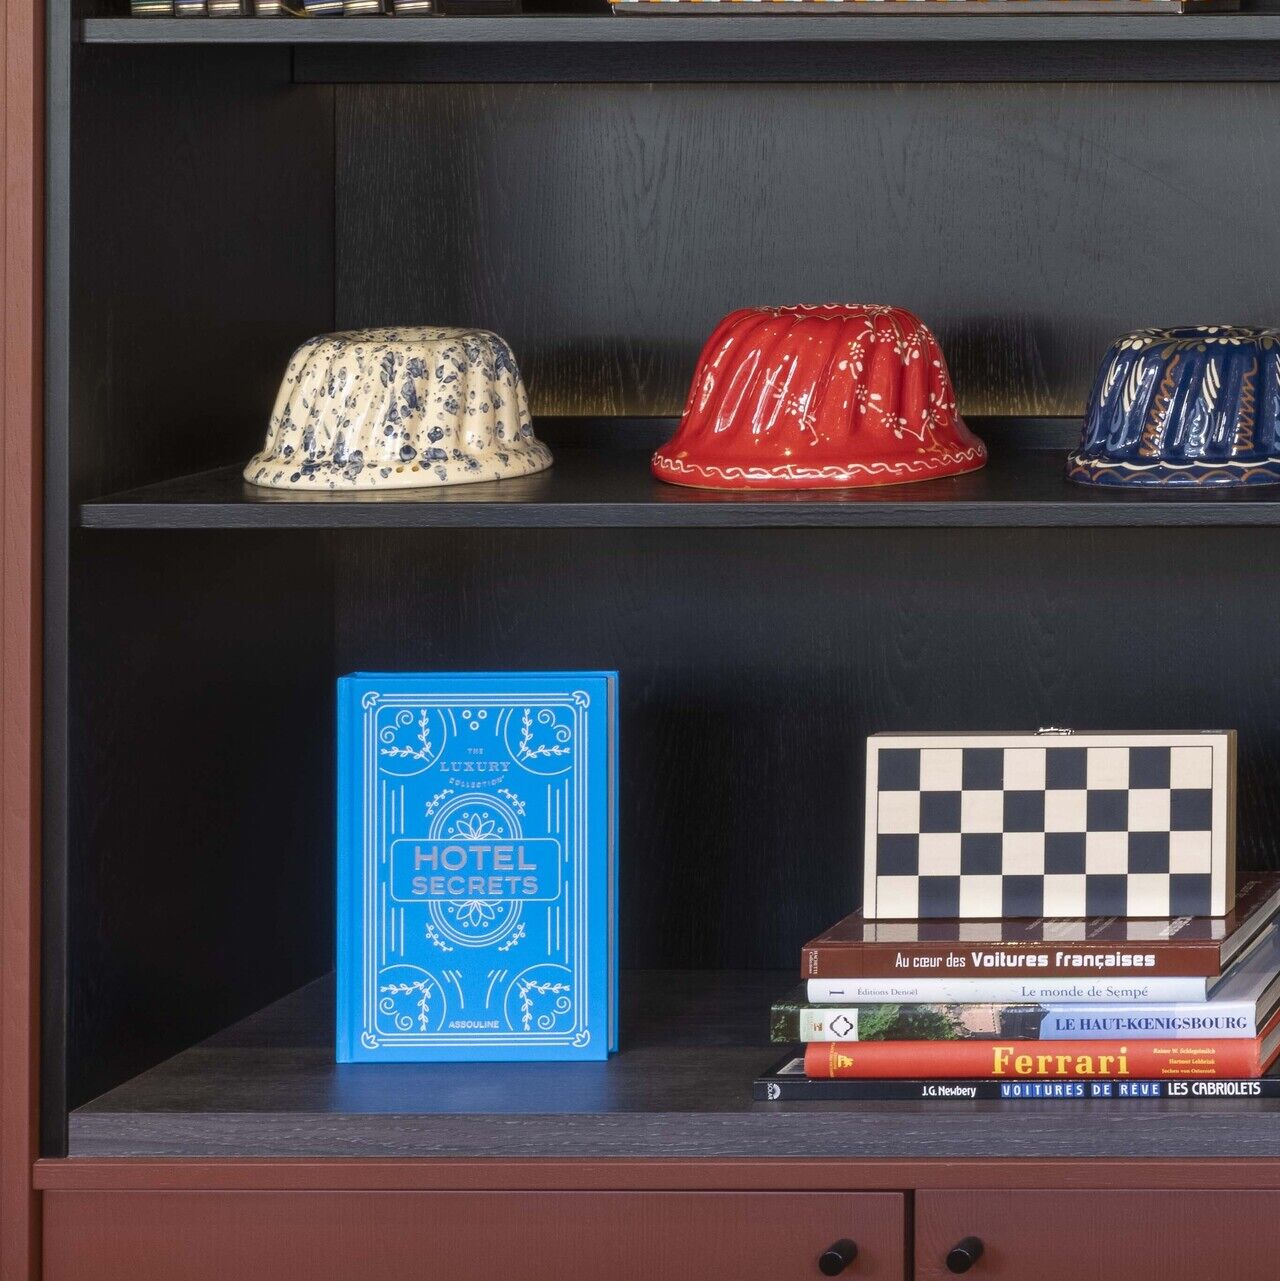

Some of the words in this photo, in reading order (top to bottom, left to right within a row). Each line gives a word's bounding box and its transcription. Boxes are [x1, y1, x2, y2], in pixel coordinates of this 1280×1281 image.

[440, 762, 511, 772] LUXURY
[449, 775, 503, 788] COLLECTION
[414, 846, 537, 871] HOTEL
[412, 876, 538, 895] SECRETS
[895, 952, 910, 968] Au
[912, 956, 942, 968] cœur
[946, 952, 966, 968] des
[971, 952, 1048, 968] Voitures
[1055, 952, 1156, 970] françaises
[857, 987, 888, 996] Éditions
[890, 988, 918, 996] Denoël
[1022, 986, 1036, 997] Le
[1040, 986, 1084, 997] monde
[1088, 986, 1102, 997] de
[1106, 986, 1149, 1000] Sempé
[448, 1020, 500, 1028] ASSOULINE
[1056, 1018, 1076, 1031] LE
[1080, 1016, 1248, 1031] HAUT-KŒNIGSBOURG
[991, 1046, 1130, 1074] Ferrari
[922, 1086, 936, 1096] J.G.
[938, 1086, 977, 1098] Newbery
[1002, 1084, 1084, 1097] VOITURES
[1092, 1084, 1111, 1097] DE
[1168, 1082, 1188, 1096] LES
[1192, 1082, 1262, 1096] CABRIOLETS
